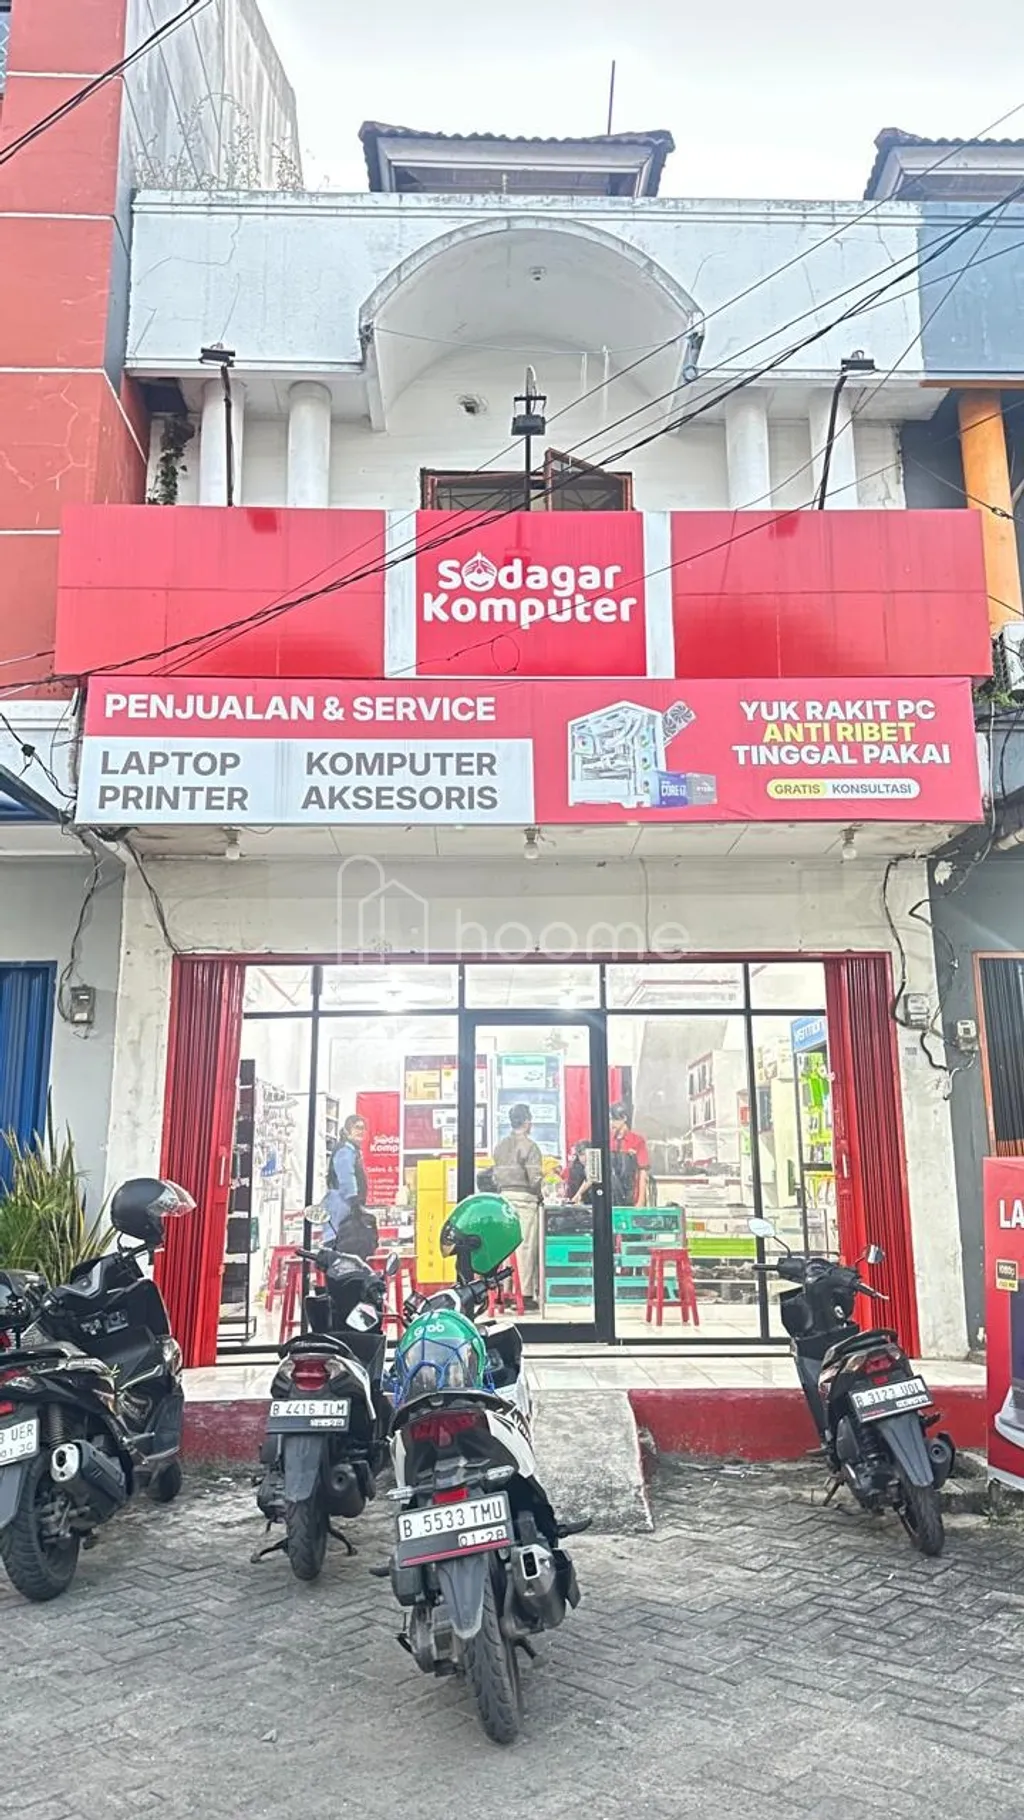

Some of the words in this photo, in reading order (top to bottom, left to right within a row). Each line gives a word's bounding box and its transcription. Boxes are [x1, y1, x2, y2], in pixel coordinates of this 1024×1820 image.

[423, 593, 637, 630] Komputer
[105, 693, 315, 721] PENJUALAN
[322, 696, 345, 721] &
[352, 696, 497, 722] SERVICE
[739, 700, 800, 721] YUK
[804, 700, 891, 721] RAKIT
[897, 699, 936, 720] PC
[762, 722, 831, 743] ANTI
[836, 722, 916, 743] RIBET
[100, 750, 241, 777] LAPTOP
[306, 752, 498, 777] KOMPUTER
[731, 744, 858, 765] TINGGAL
[863, 743, 951, 764] PAKAI
[98, 785, 249, 811] PRINTER
[301, 786, 499, 811] AKSESORIS
[774, 783, 821, 795] GRATIS
[832, 783, 912, 795] KONSULTASI
[273, 1403, 280, 1416] B
[286, 1403, 316, 1416] 4416
[11, 1423, 34, 1441] UER
[403, 1519, 413, 1539] B
[423, 1508, 465, 1534] 5533
[471, 1500, 502, 1524] TMU
